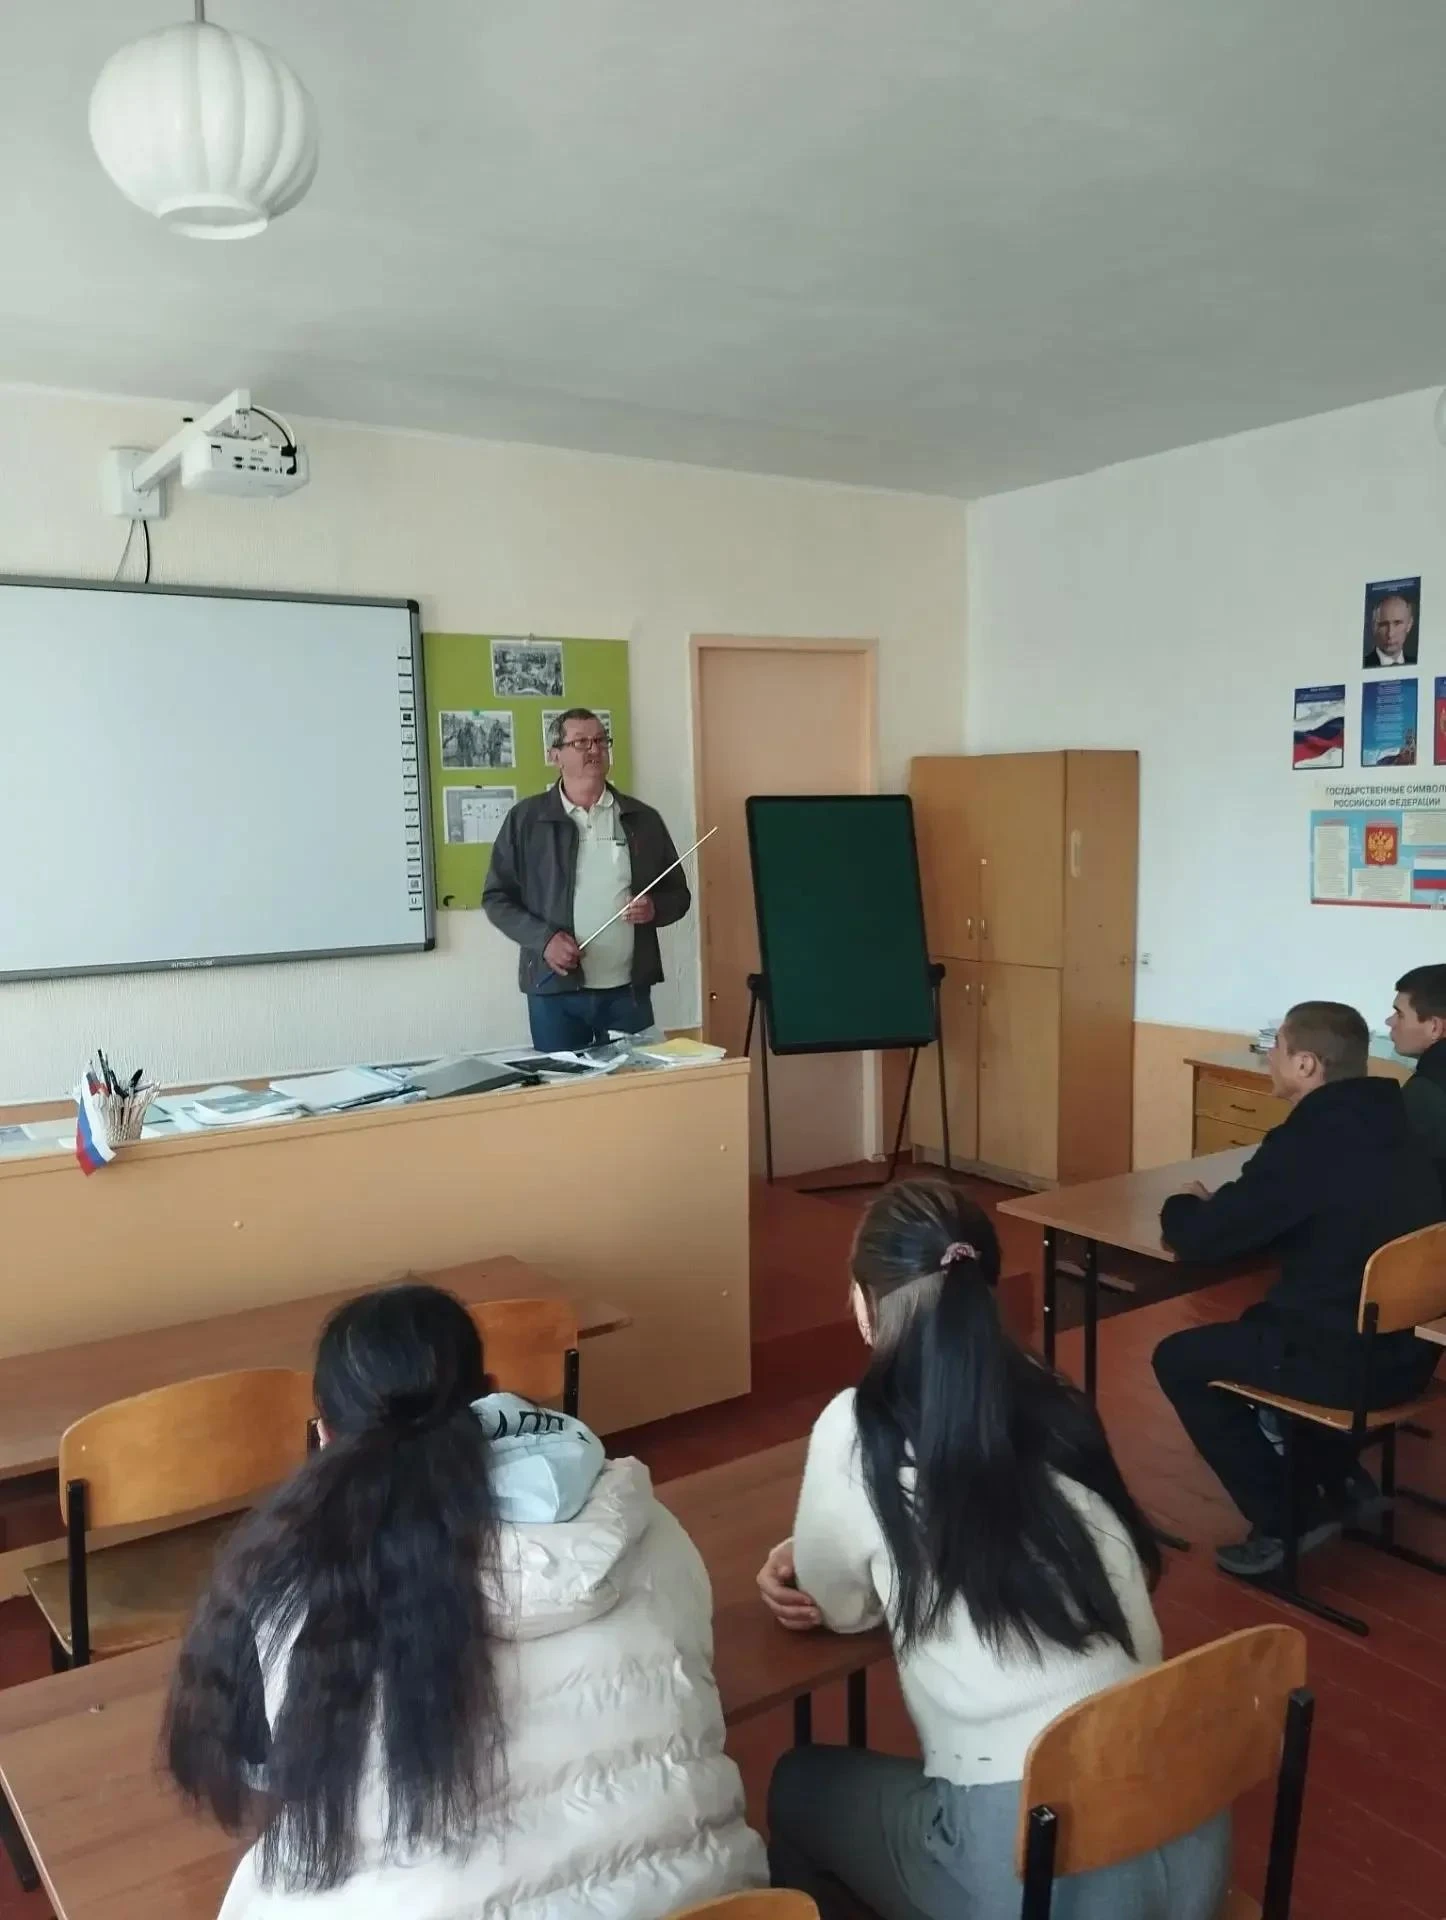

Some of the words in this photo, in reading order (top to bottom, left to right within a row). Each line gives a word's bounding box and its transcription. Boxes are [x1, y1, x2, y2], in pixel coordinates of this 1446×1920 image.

[1326, 785, 1405, 795] ГОСУДАРСТВЕННЫЕ
[1406, 784, 1446, 793] СИМВОЛ
[1333, 798, 1386, 808] РОССИЙСКОЙ
[1388, 798, 1440, 807] ФЕДЕРАЦИИ
